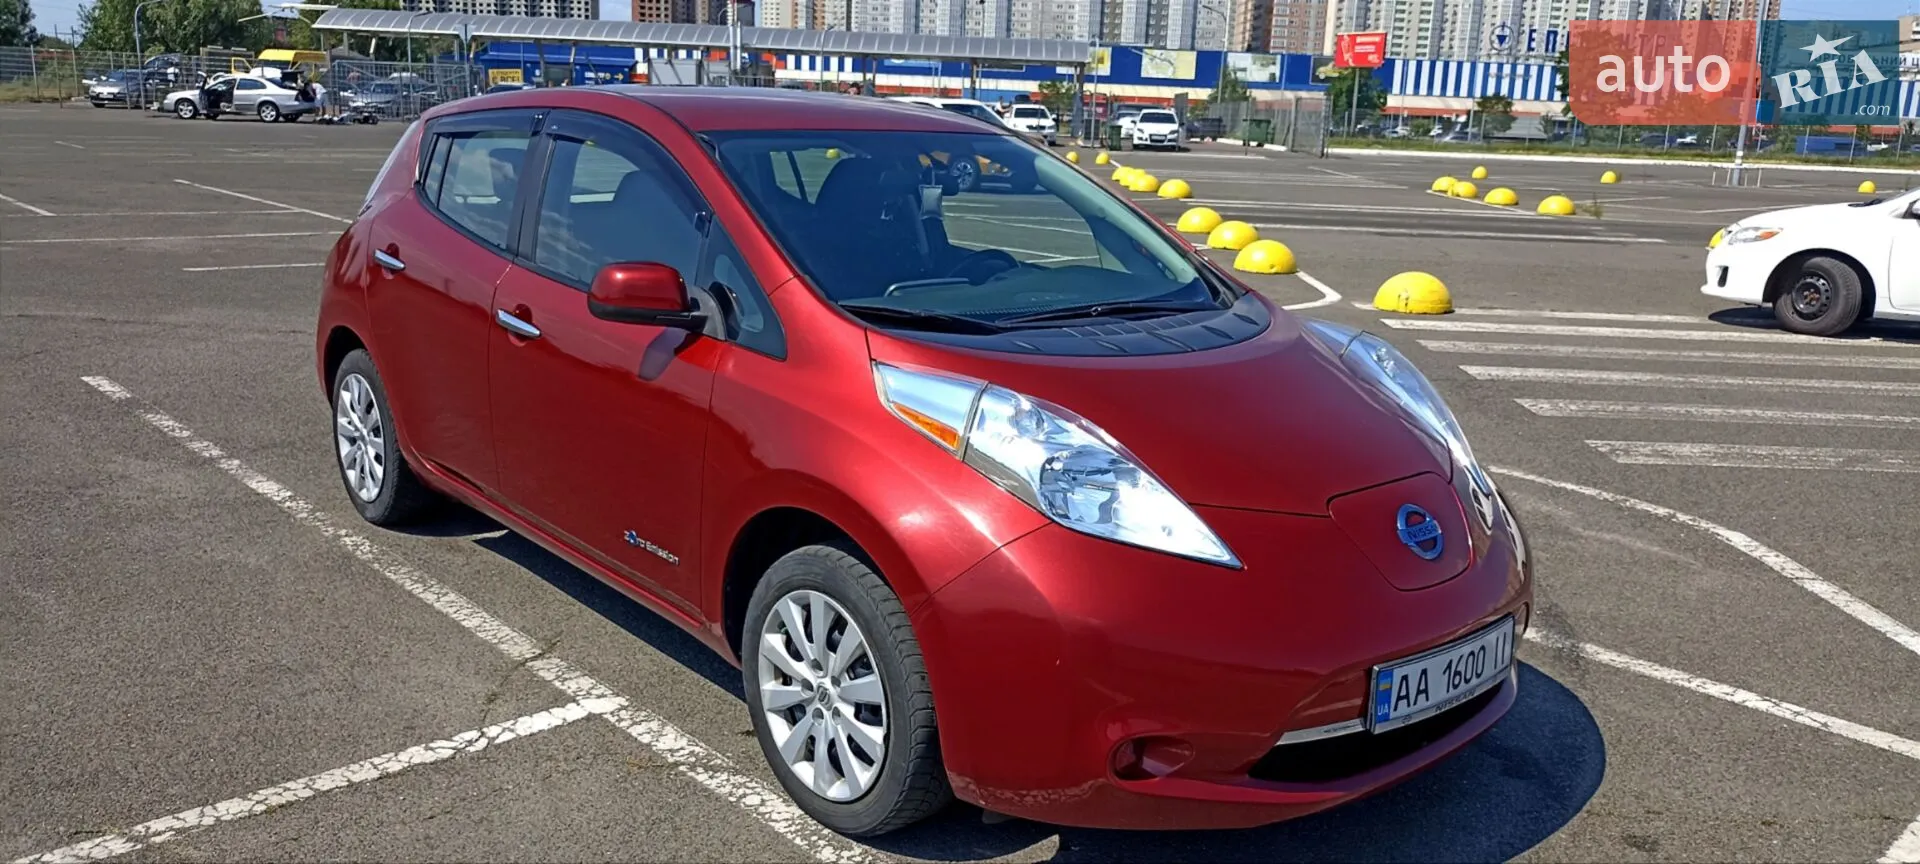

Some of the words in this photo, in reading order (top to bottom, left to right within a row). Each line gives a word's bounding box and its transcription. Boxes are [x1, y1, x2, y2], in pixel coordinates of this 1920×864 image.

[1393, 667, 1430, 712] AA
[1442, 644, 1486, 694] 1600
[1377, 703, 1390, 716] UA
